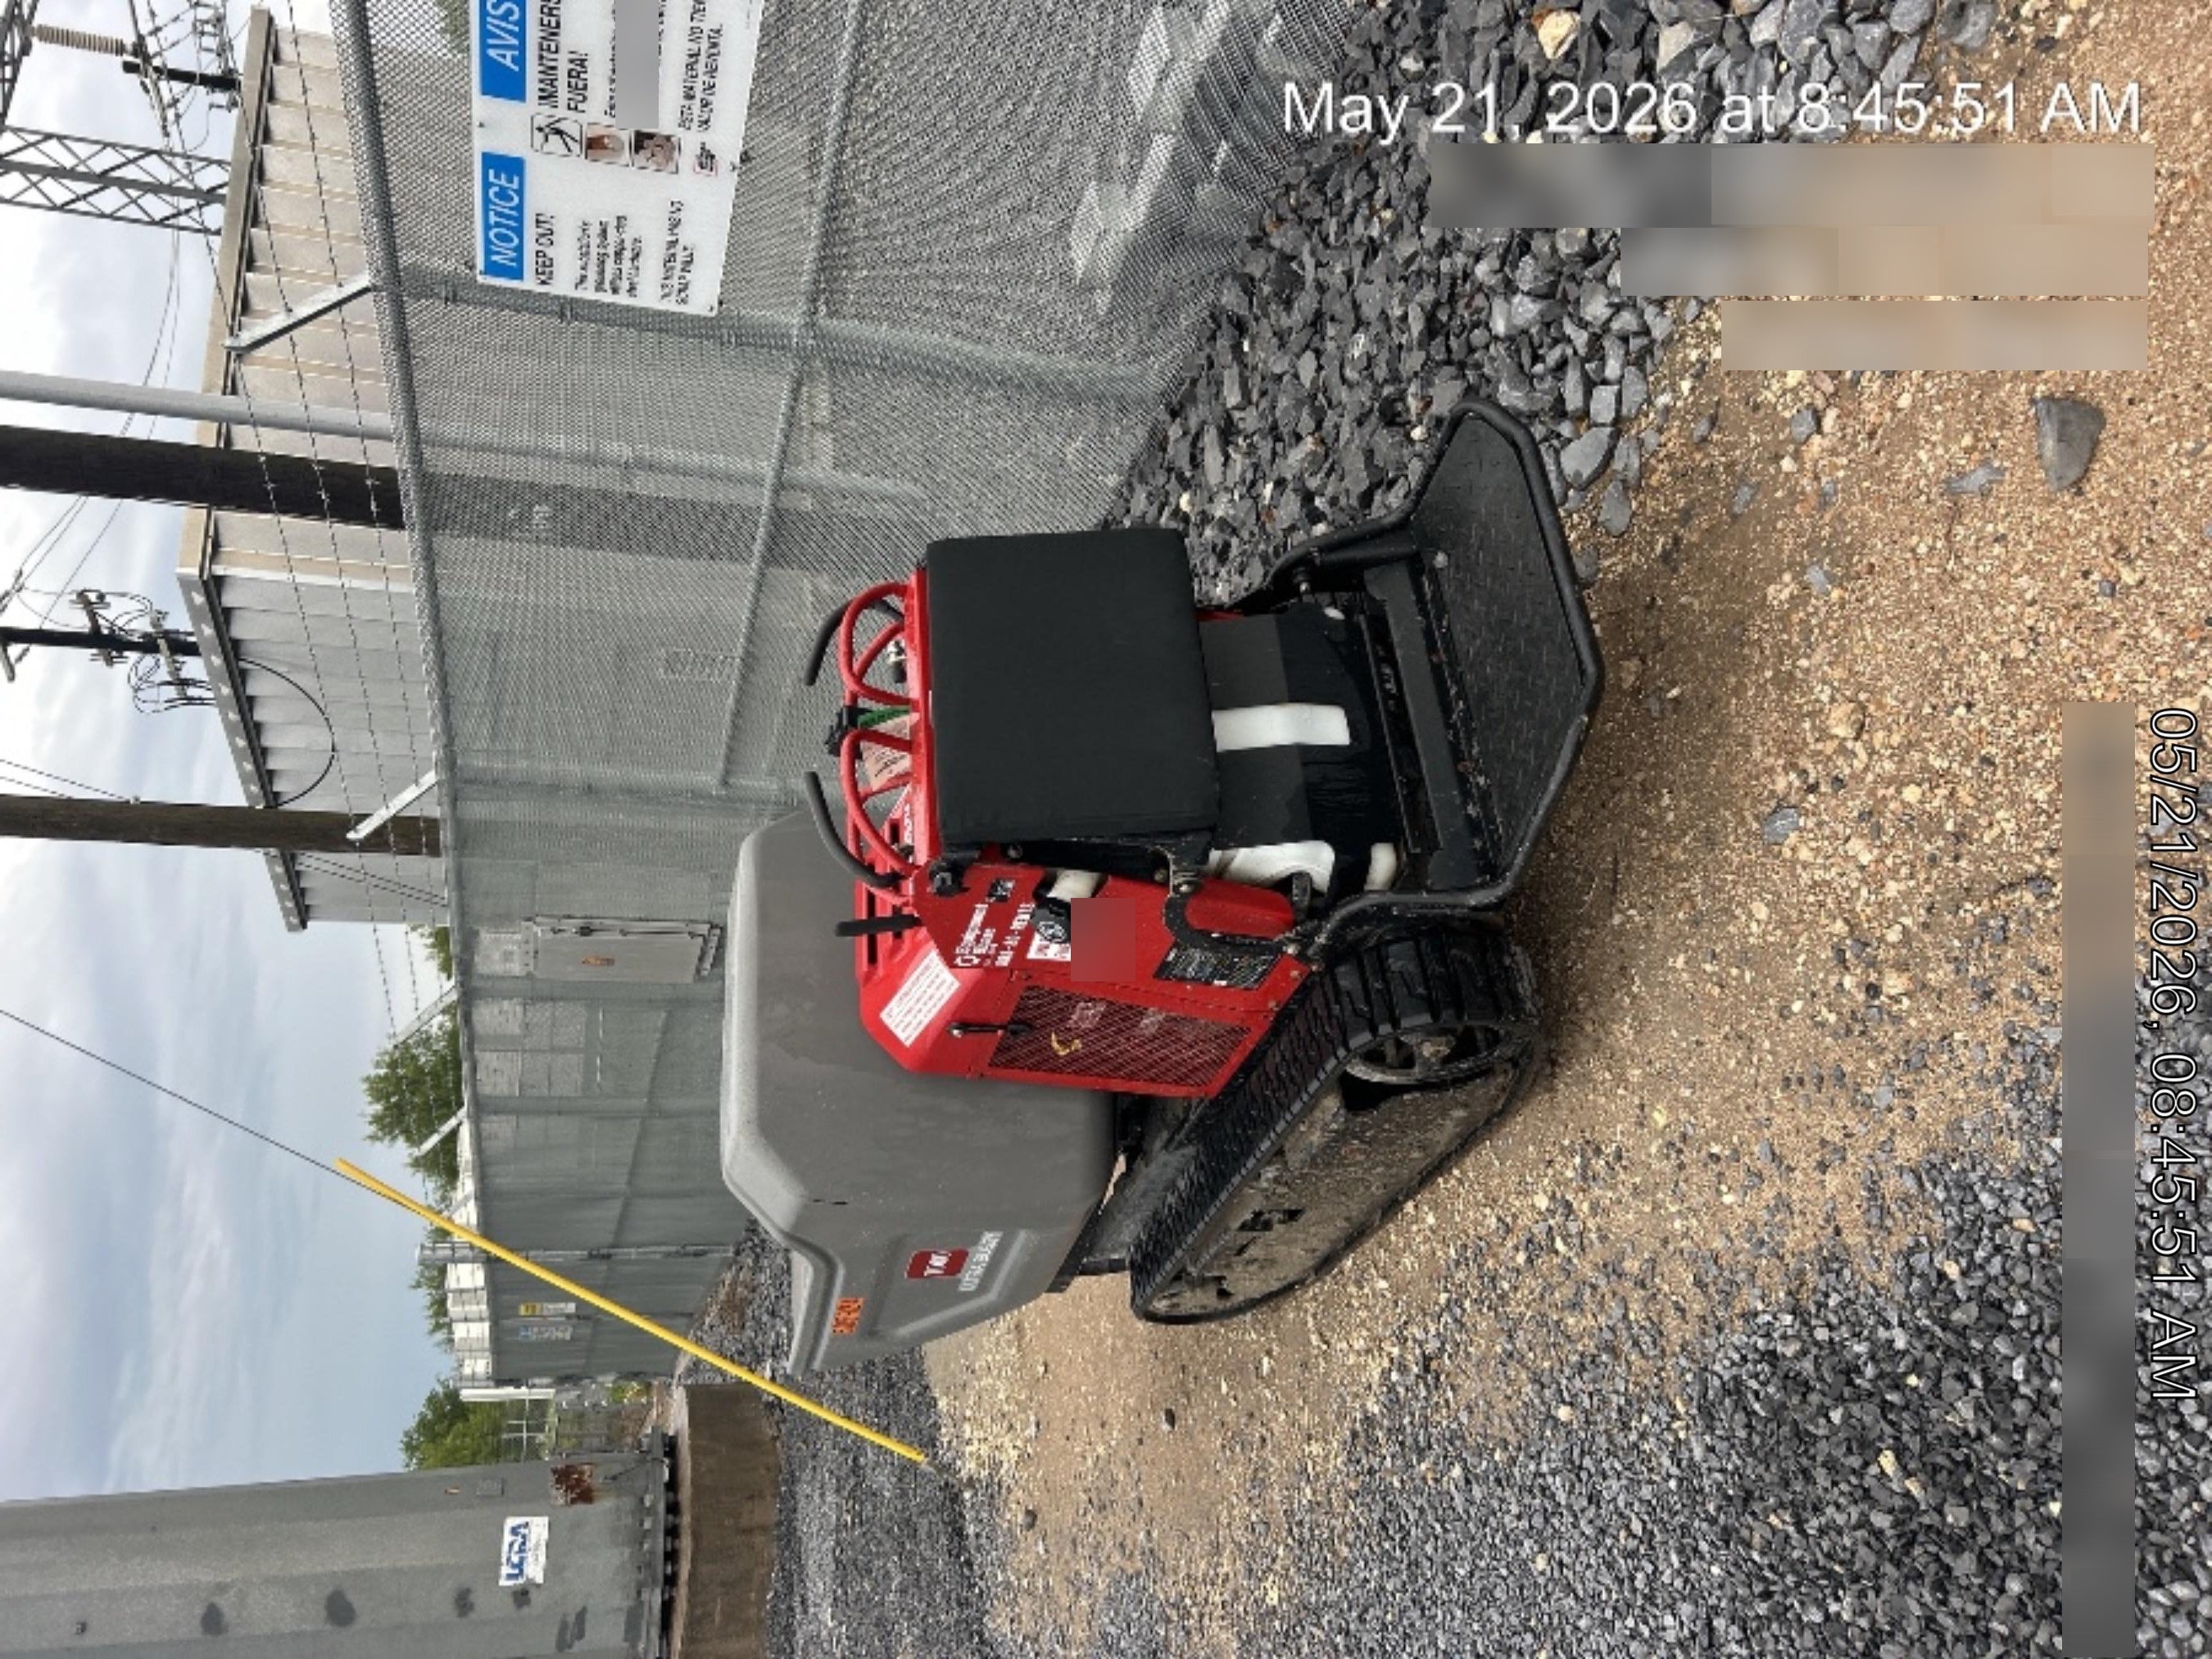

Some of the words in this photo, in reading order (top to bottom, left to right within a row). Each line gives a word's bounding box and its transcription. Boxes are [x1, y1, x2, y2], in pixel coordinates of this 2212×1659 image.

[567, 51, 588, 113] FUERA!
[488, 168, 520, 267] NOTICE
[534, 212, 555, 247] OUT!
[534, 249, 554, 286] KEEP
